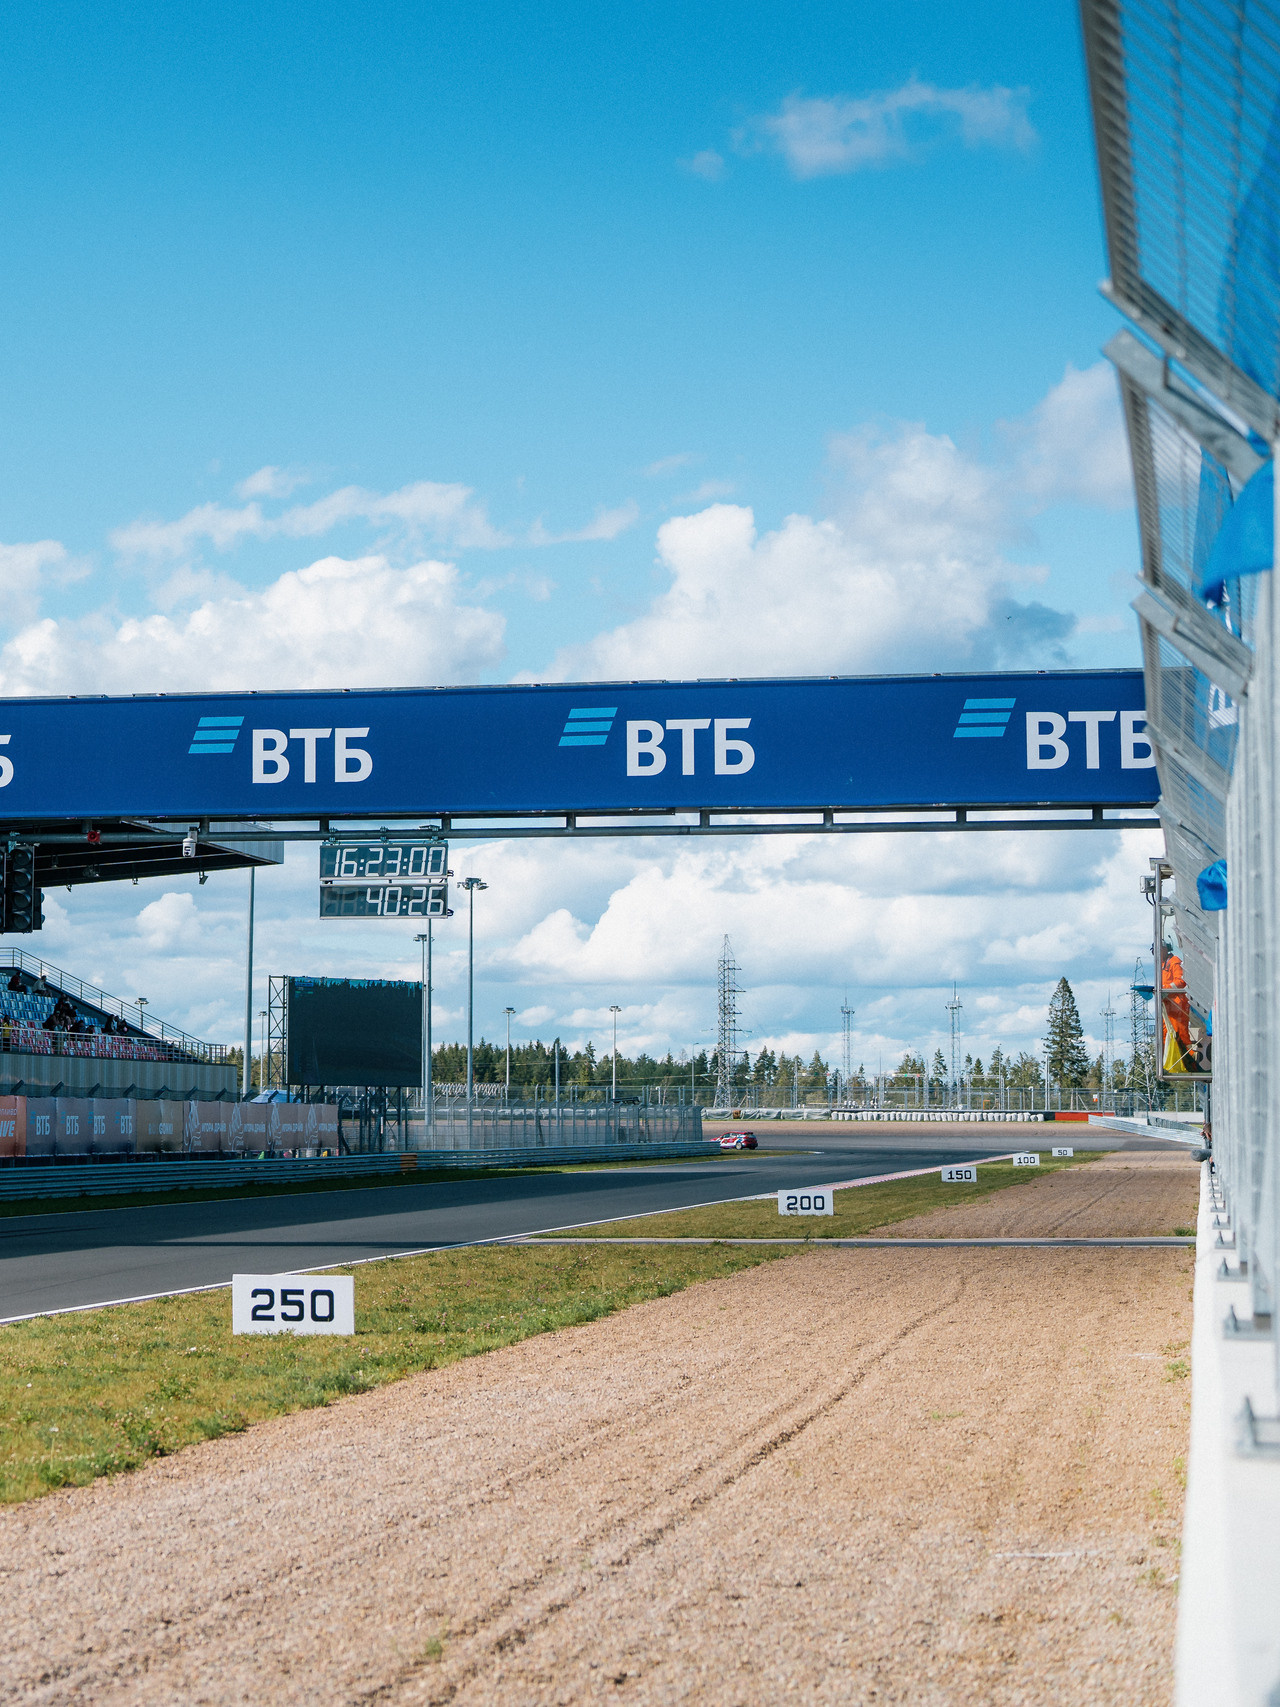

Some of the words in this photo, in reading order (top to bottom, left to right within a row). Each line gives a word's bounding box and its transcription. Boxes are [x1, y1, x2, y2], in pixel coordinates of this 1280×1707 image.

[626, 717, 755, 777] ВТБ
[1025, 710, 1157, 770] ВТБ
[253, 727, 373, 784] ВТБ
[334, 846, 446, 877] 16:23:00
[366, 886, 444, 916] 40:26
[35, 1115, 51, 1136] ВТБ
[66, 1115, 80, 1135] ВТБ
[93, 1115, 106, 1135] ВТБ
[120, 1115, 133, 1135] ВТБ
[1017, 1156, 1036, 1164] 100
[947, 1170, 972, 1180] 150
[786, 1195, 825, 1210] 200
[251, 1288, 335, 1322] 250
